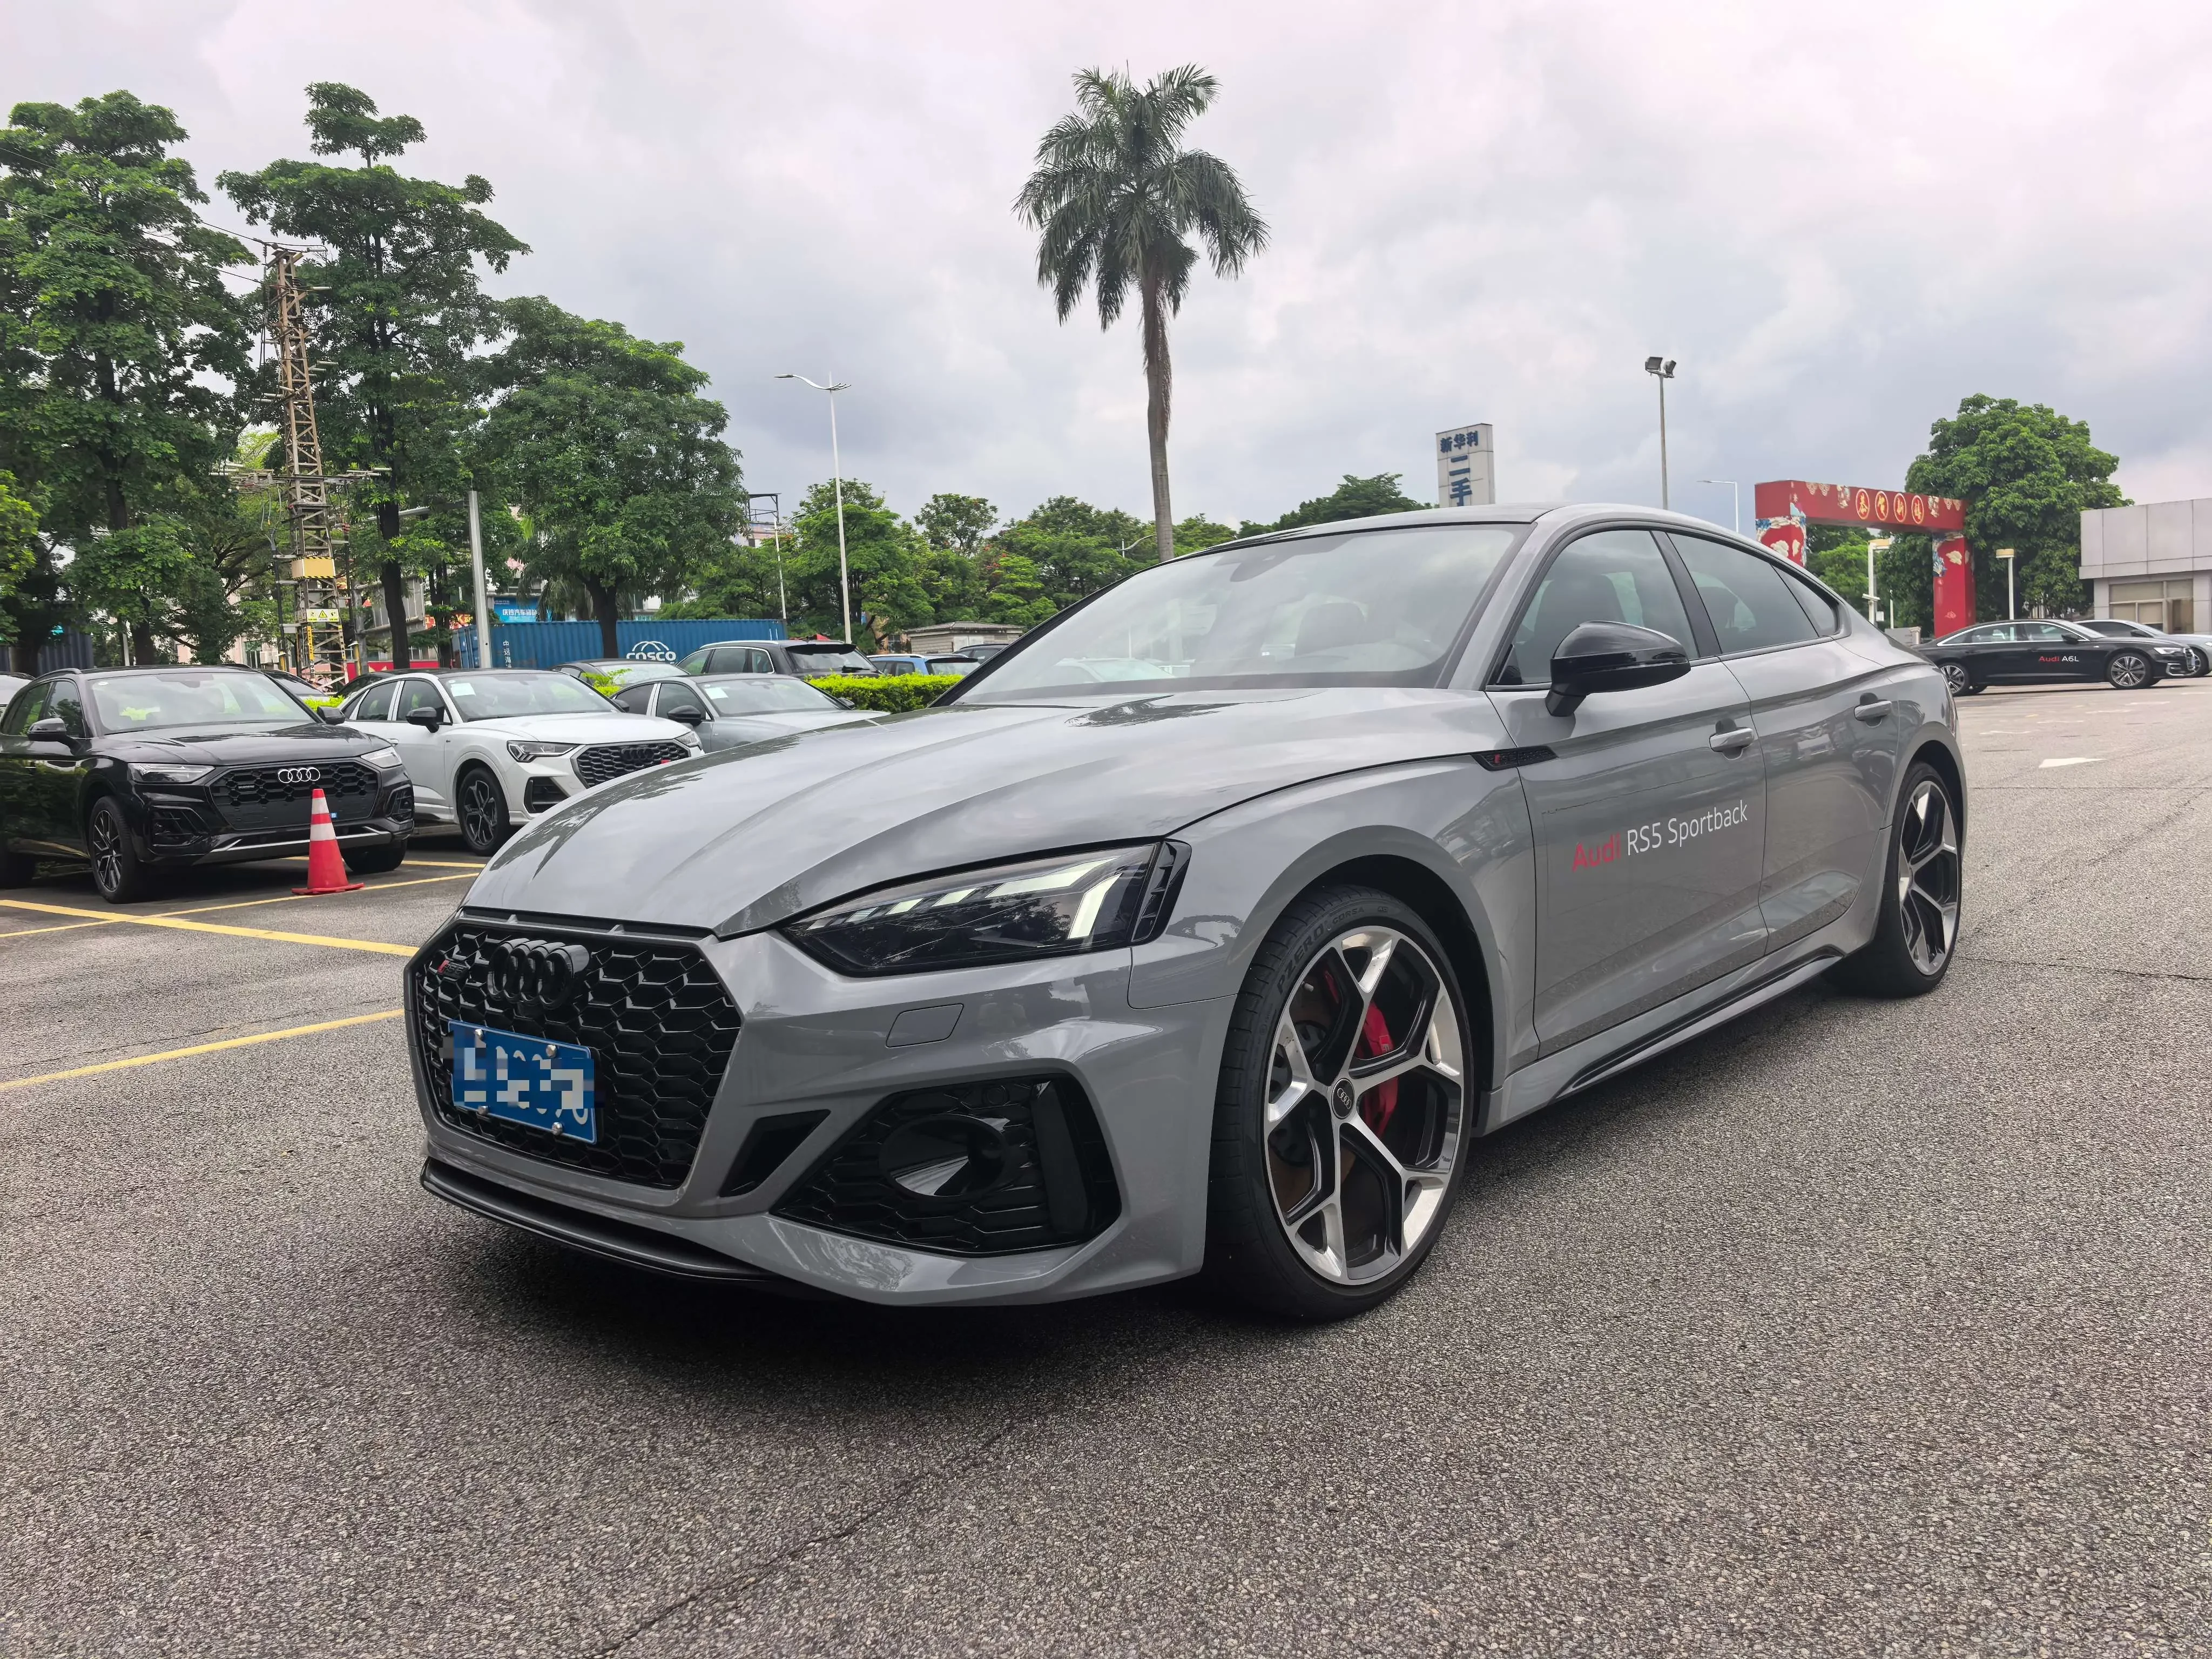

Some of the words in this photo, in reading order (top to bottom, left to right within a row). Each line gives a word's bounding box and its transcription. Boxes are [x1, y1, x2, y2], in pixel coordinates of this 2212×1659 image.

[1440, 430, 1479, 453] 新华利
[1572, 832, 1621, 872] Audi
[1627, 822, 1662, 856] RS5
[1668, 799, 1748, 847] Sportback
[1332, 907, 1365, 925] CORSA
